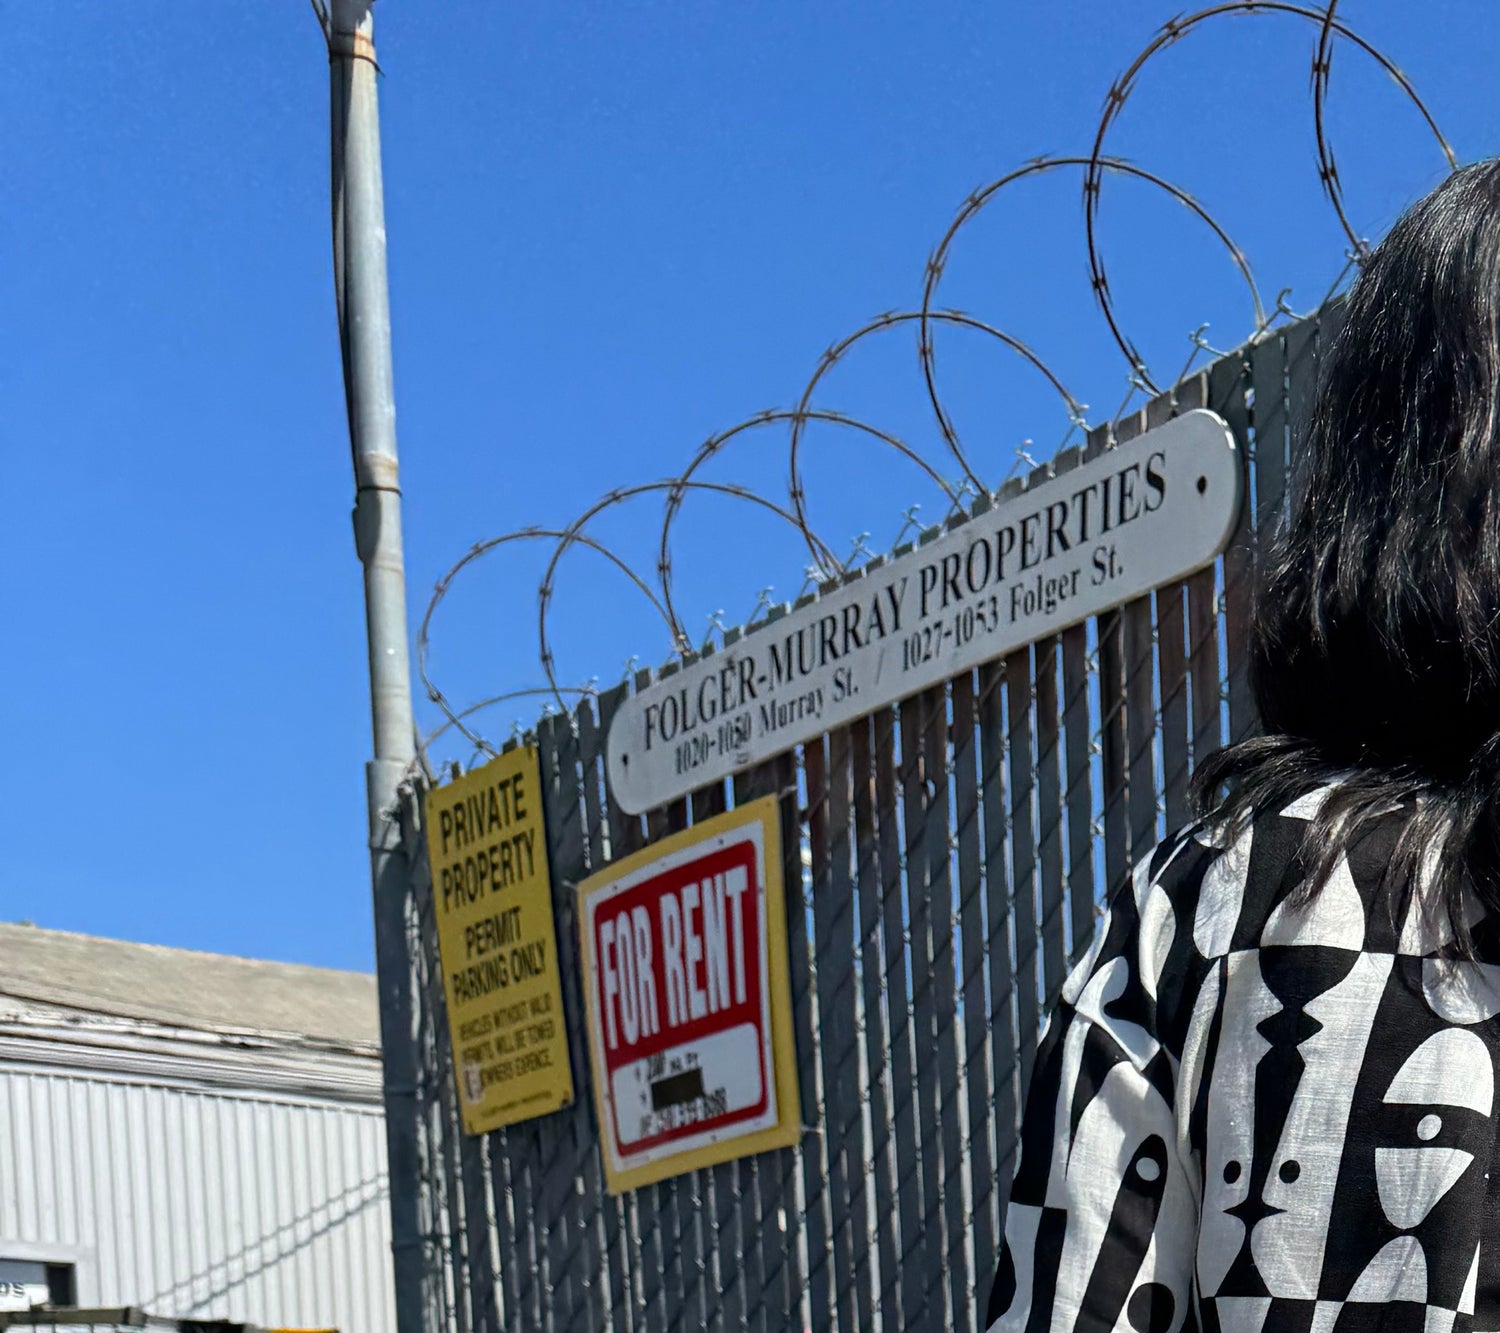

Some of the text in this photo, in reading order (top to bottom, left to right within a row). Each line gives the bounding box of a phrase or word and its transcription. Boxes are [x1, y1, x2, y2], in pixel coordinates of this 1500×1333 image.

[643, 450, 1166, 751] FOLGER-MURRAY PROPERTIES
[758, 688, 826, 738] Murray
[832, 666, 859, 701] St.
[902, 596, 998, 672] 1027-1053
[1009, 569, 1081, 623] Folger
[1091, 546, 1123, 586] St.
[438, 771, 528, 856] PRIVATE
[440, 827, 535, 914] PROPERTY
[451, 937, 546, 1006] PARKING ONLY
[465, 905, 522, 961] PERMIT
[600, 864, 749, 1051] FOR RENT
